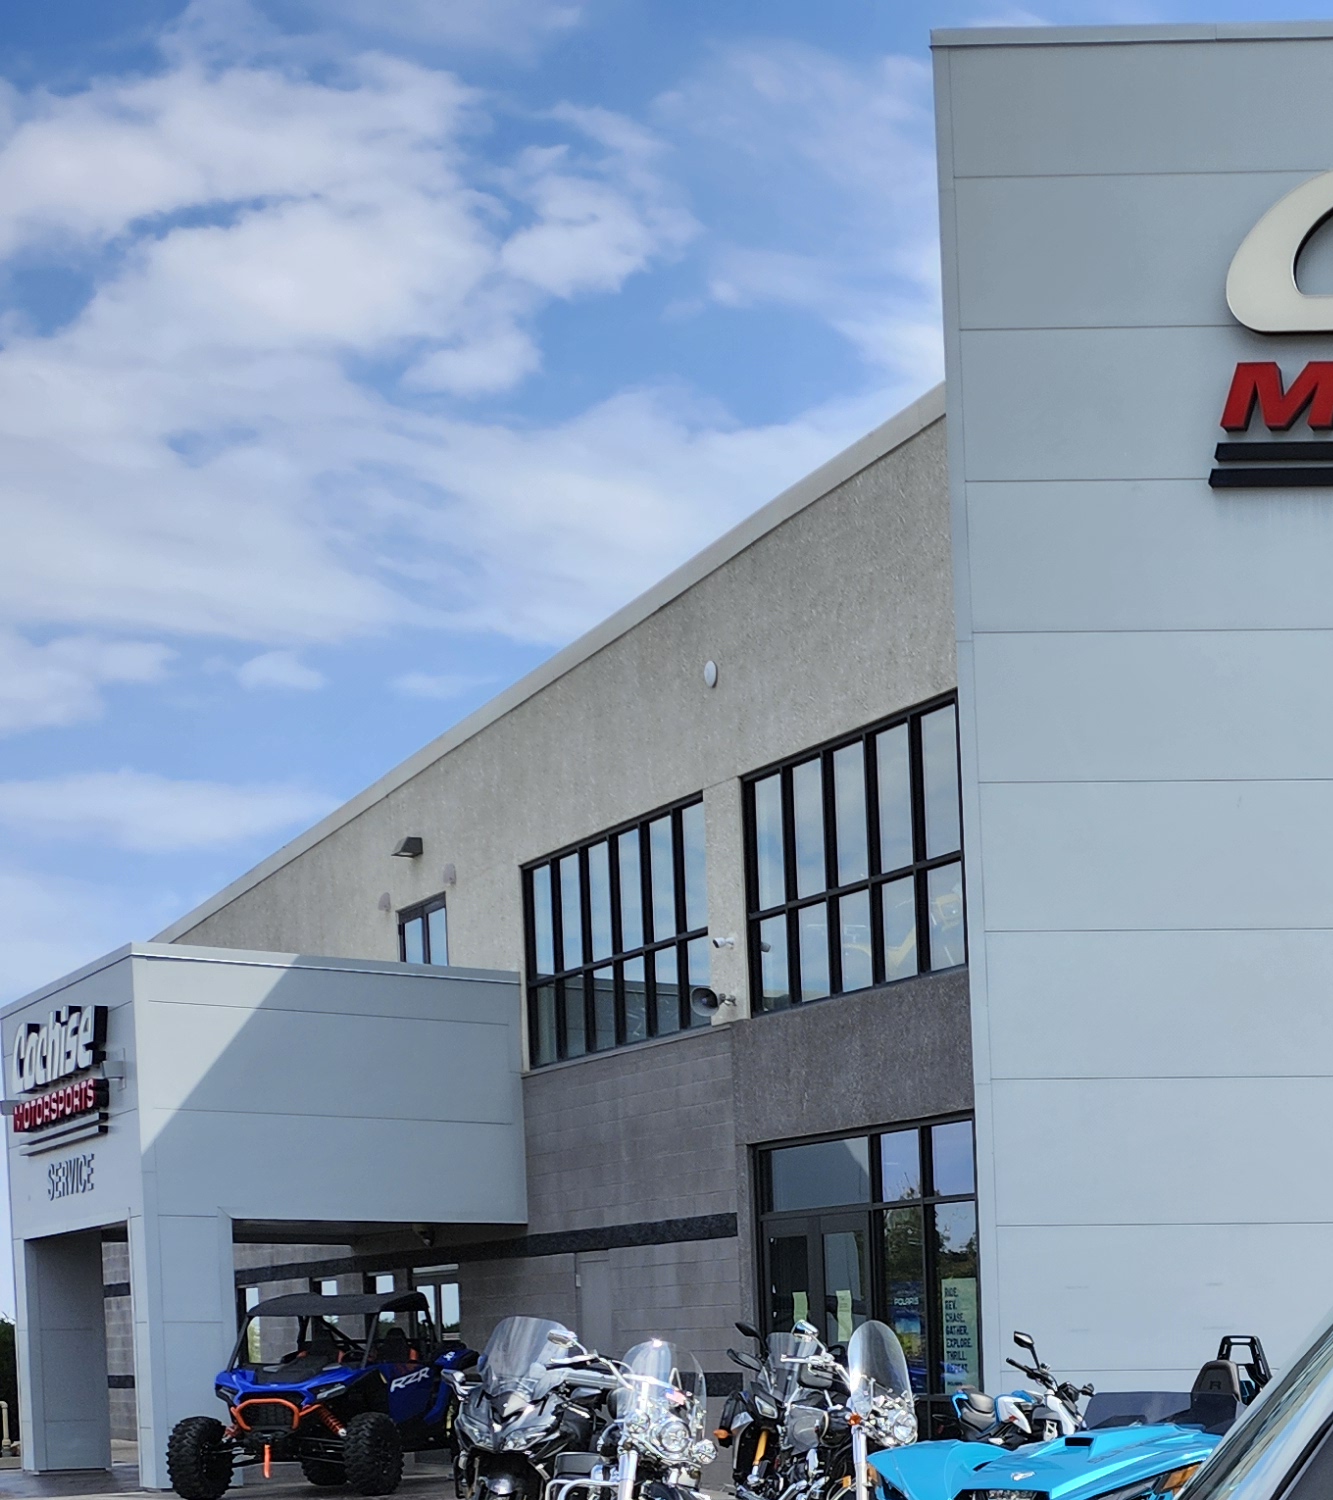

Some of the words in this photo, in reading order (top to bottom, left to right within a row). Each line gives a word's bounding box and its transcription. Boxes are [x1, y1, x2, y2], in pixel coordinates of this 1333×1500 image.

[12, 1005, 100, 1094] Cochise
[14, 1078, 100, 1133] MOTORSPORTS
[48, 1153, 96, 1202] SERVICE
[893, 1297, 920, 1306] POLARIS
[390, 1366, 430, 1393] RZR
